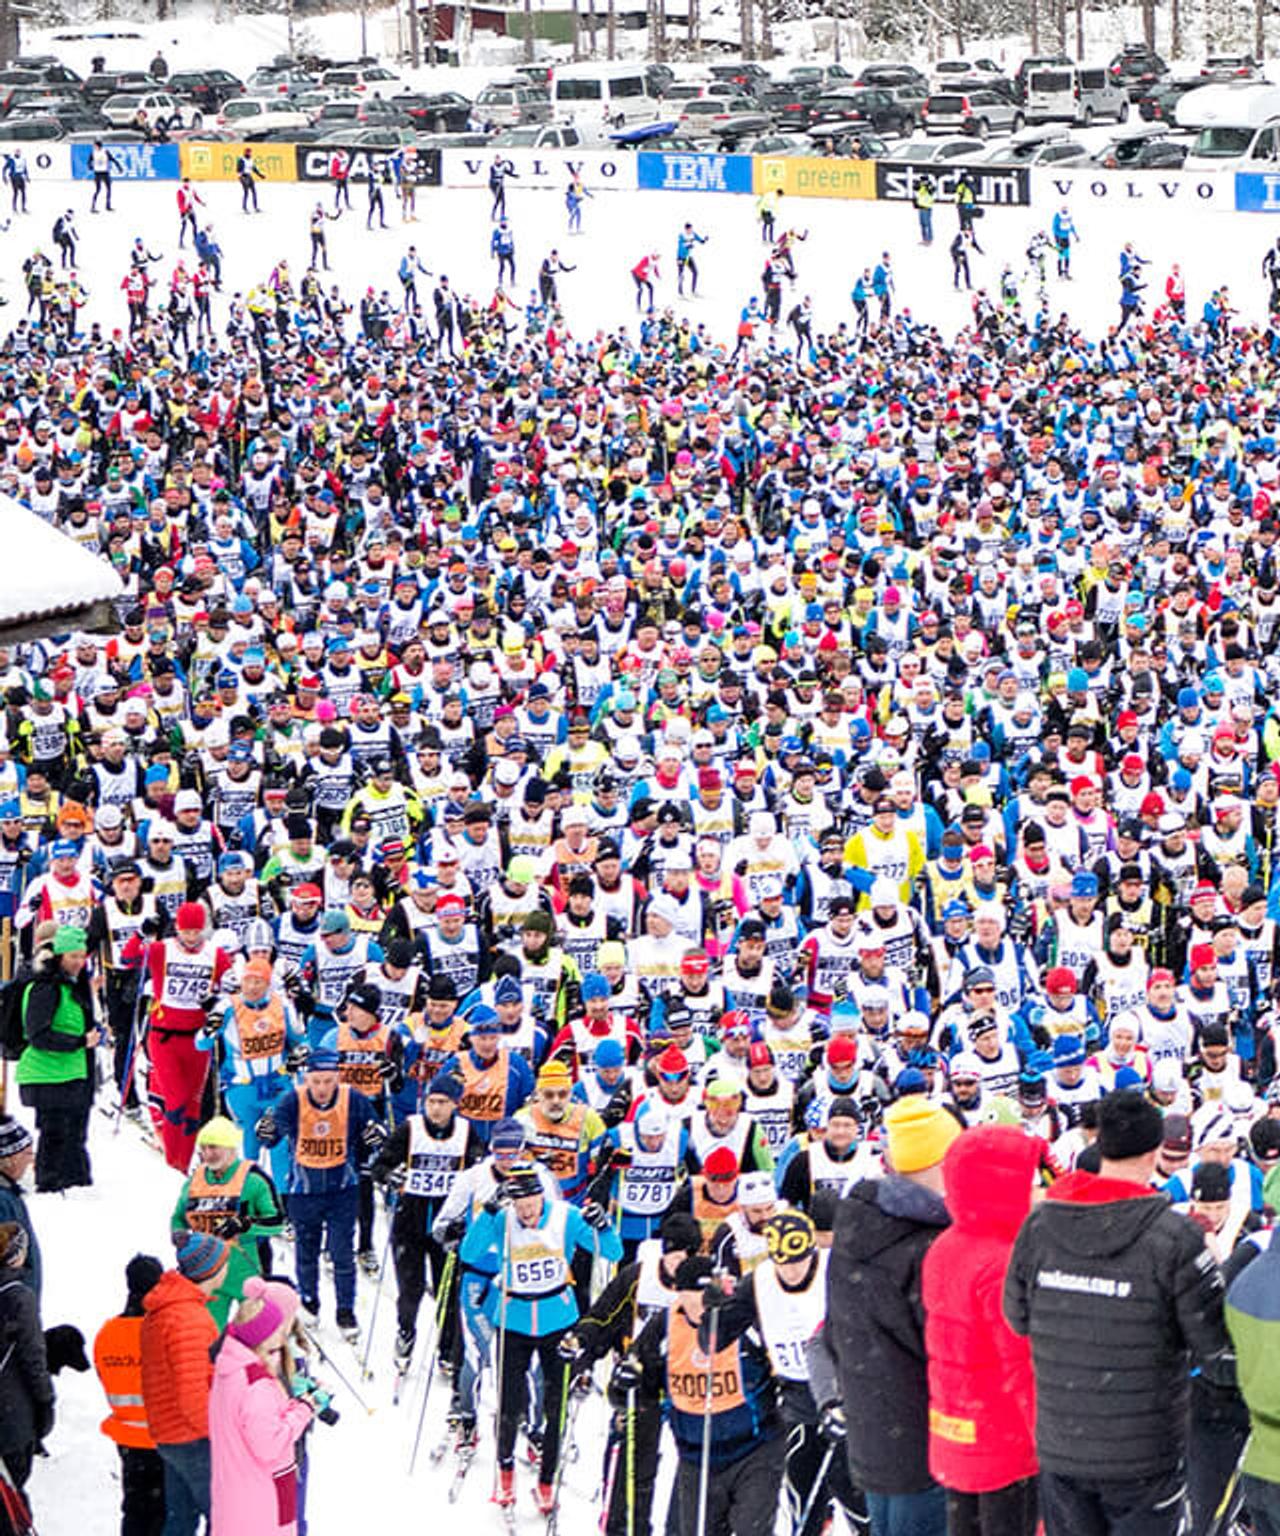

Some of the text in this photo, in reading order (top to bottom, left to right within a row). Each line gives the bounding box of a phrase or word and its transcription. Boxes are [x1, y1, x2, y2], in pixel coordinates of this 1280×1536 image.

[663, 156, 727, 189] IBM
[798, 169, 861, 191] preem
[1053, 181, 1214, 199] VOLVO
